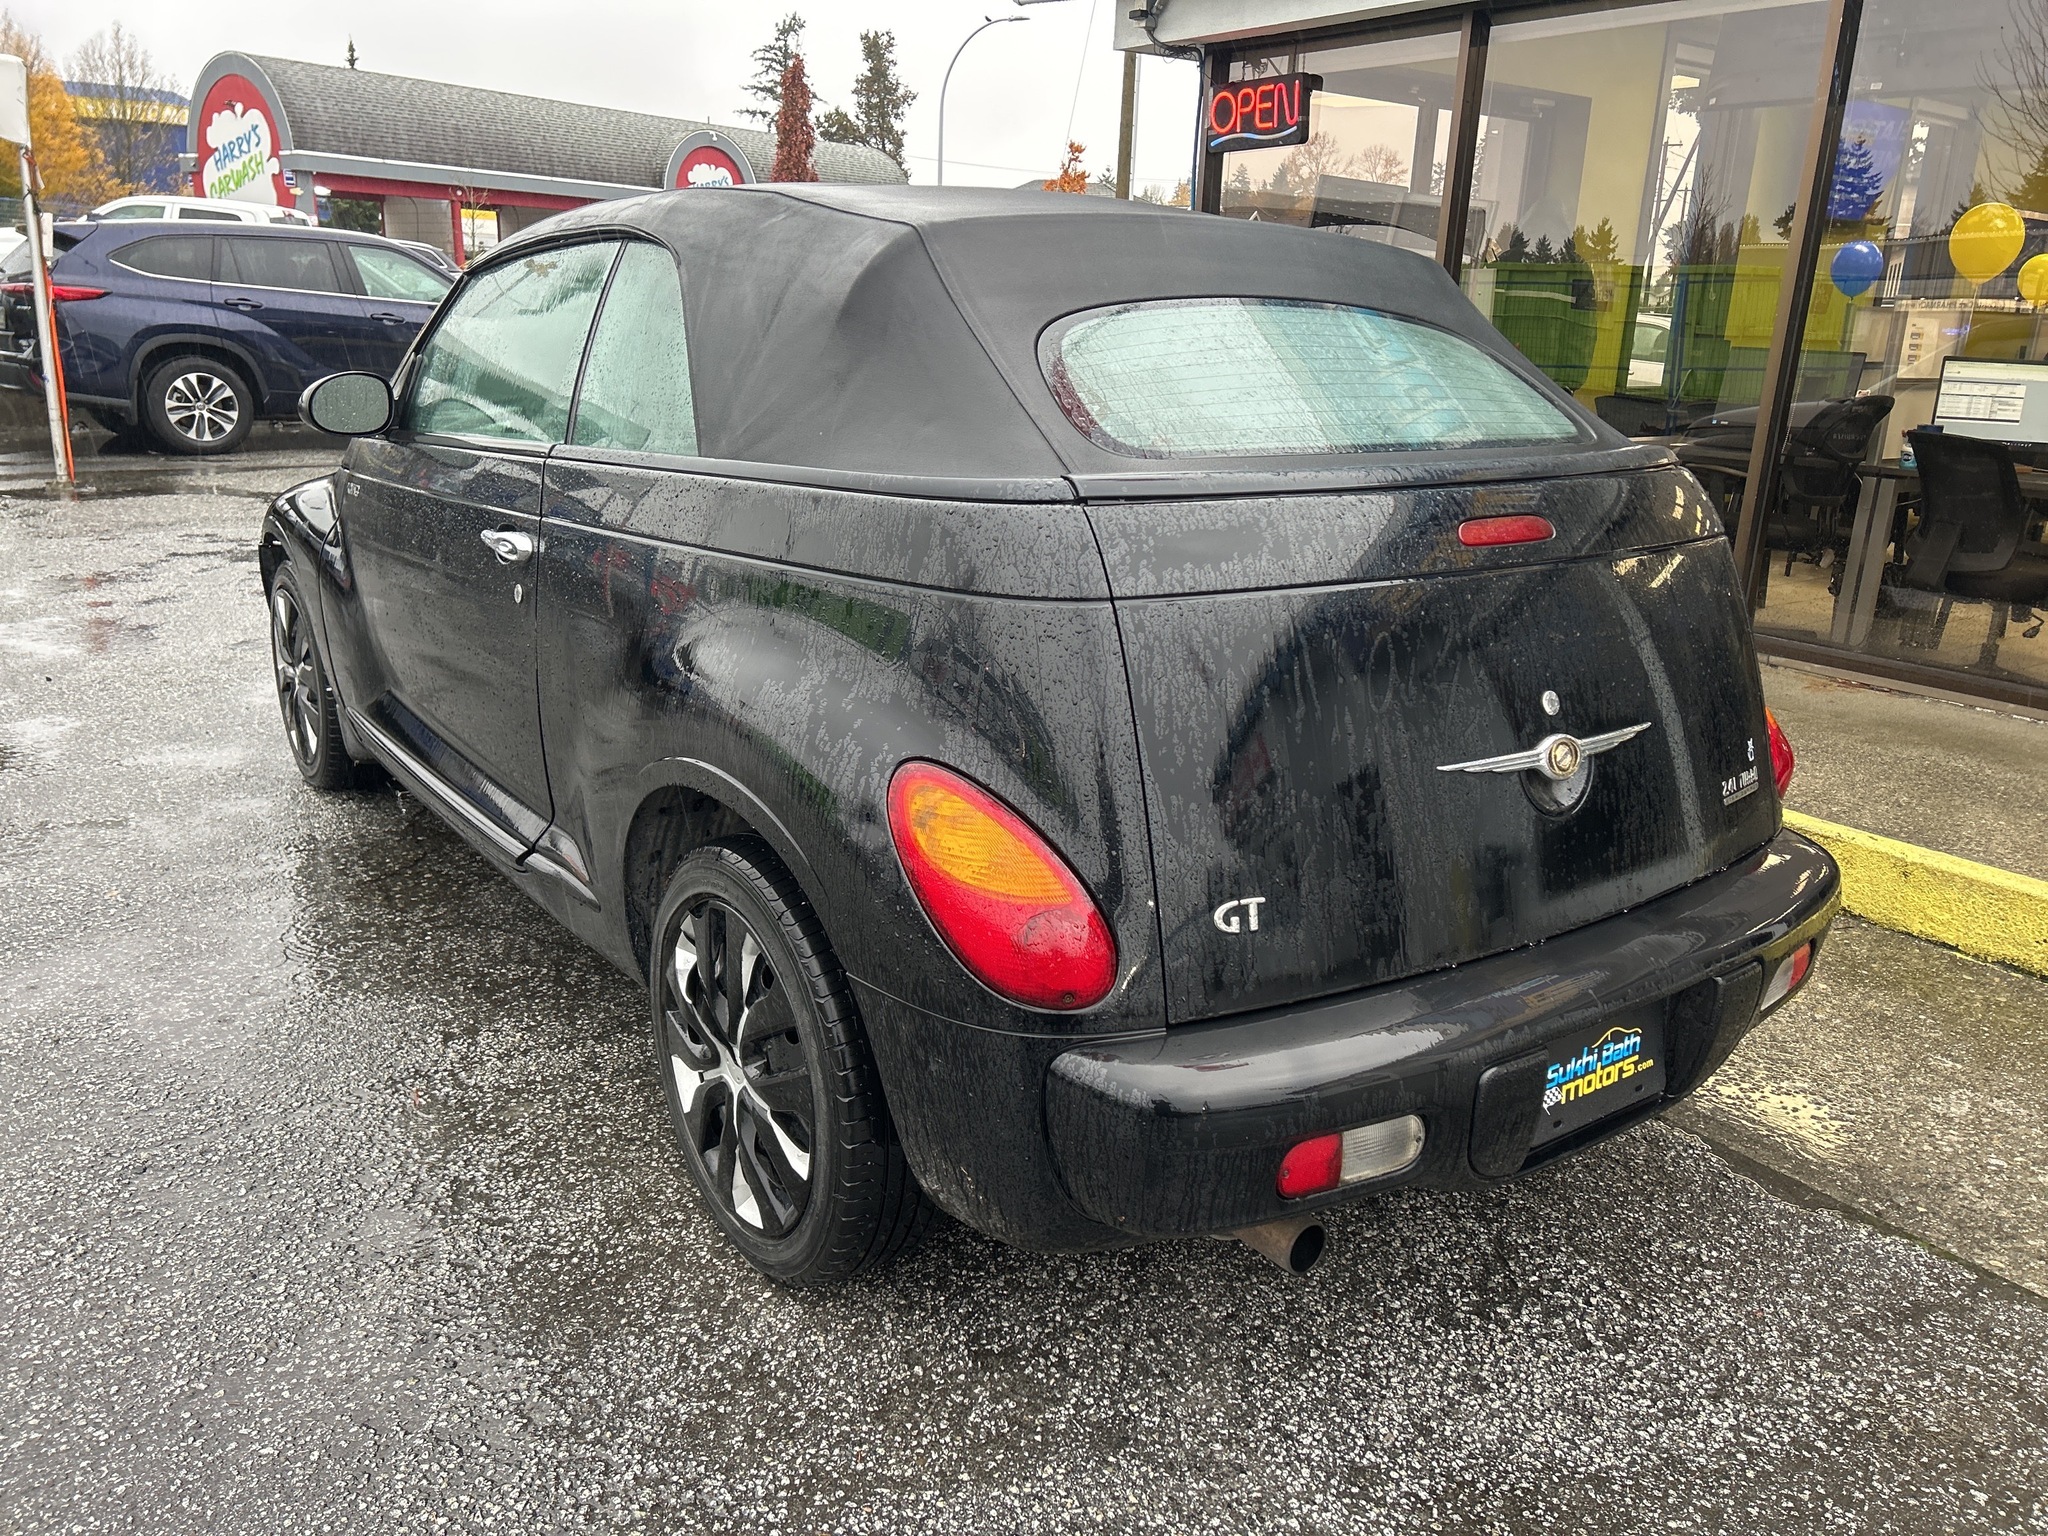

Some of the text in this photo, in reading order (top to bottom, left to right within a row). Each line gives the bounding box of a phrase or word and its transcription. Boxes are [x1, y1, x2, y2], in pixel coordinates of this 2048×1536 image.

[1210, 80, 1300, 134] OPEN
[213, 124, 261, 172] HARRY'S
[210, 150, 265, 199] CARWASH
[1213, 896, 1266, 933] GT
[1546, 1033, 1641, 1089] Sukhi Bath
